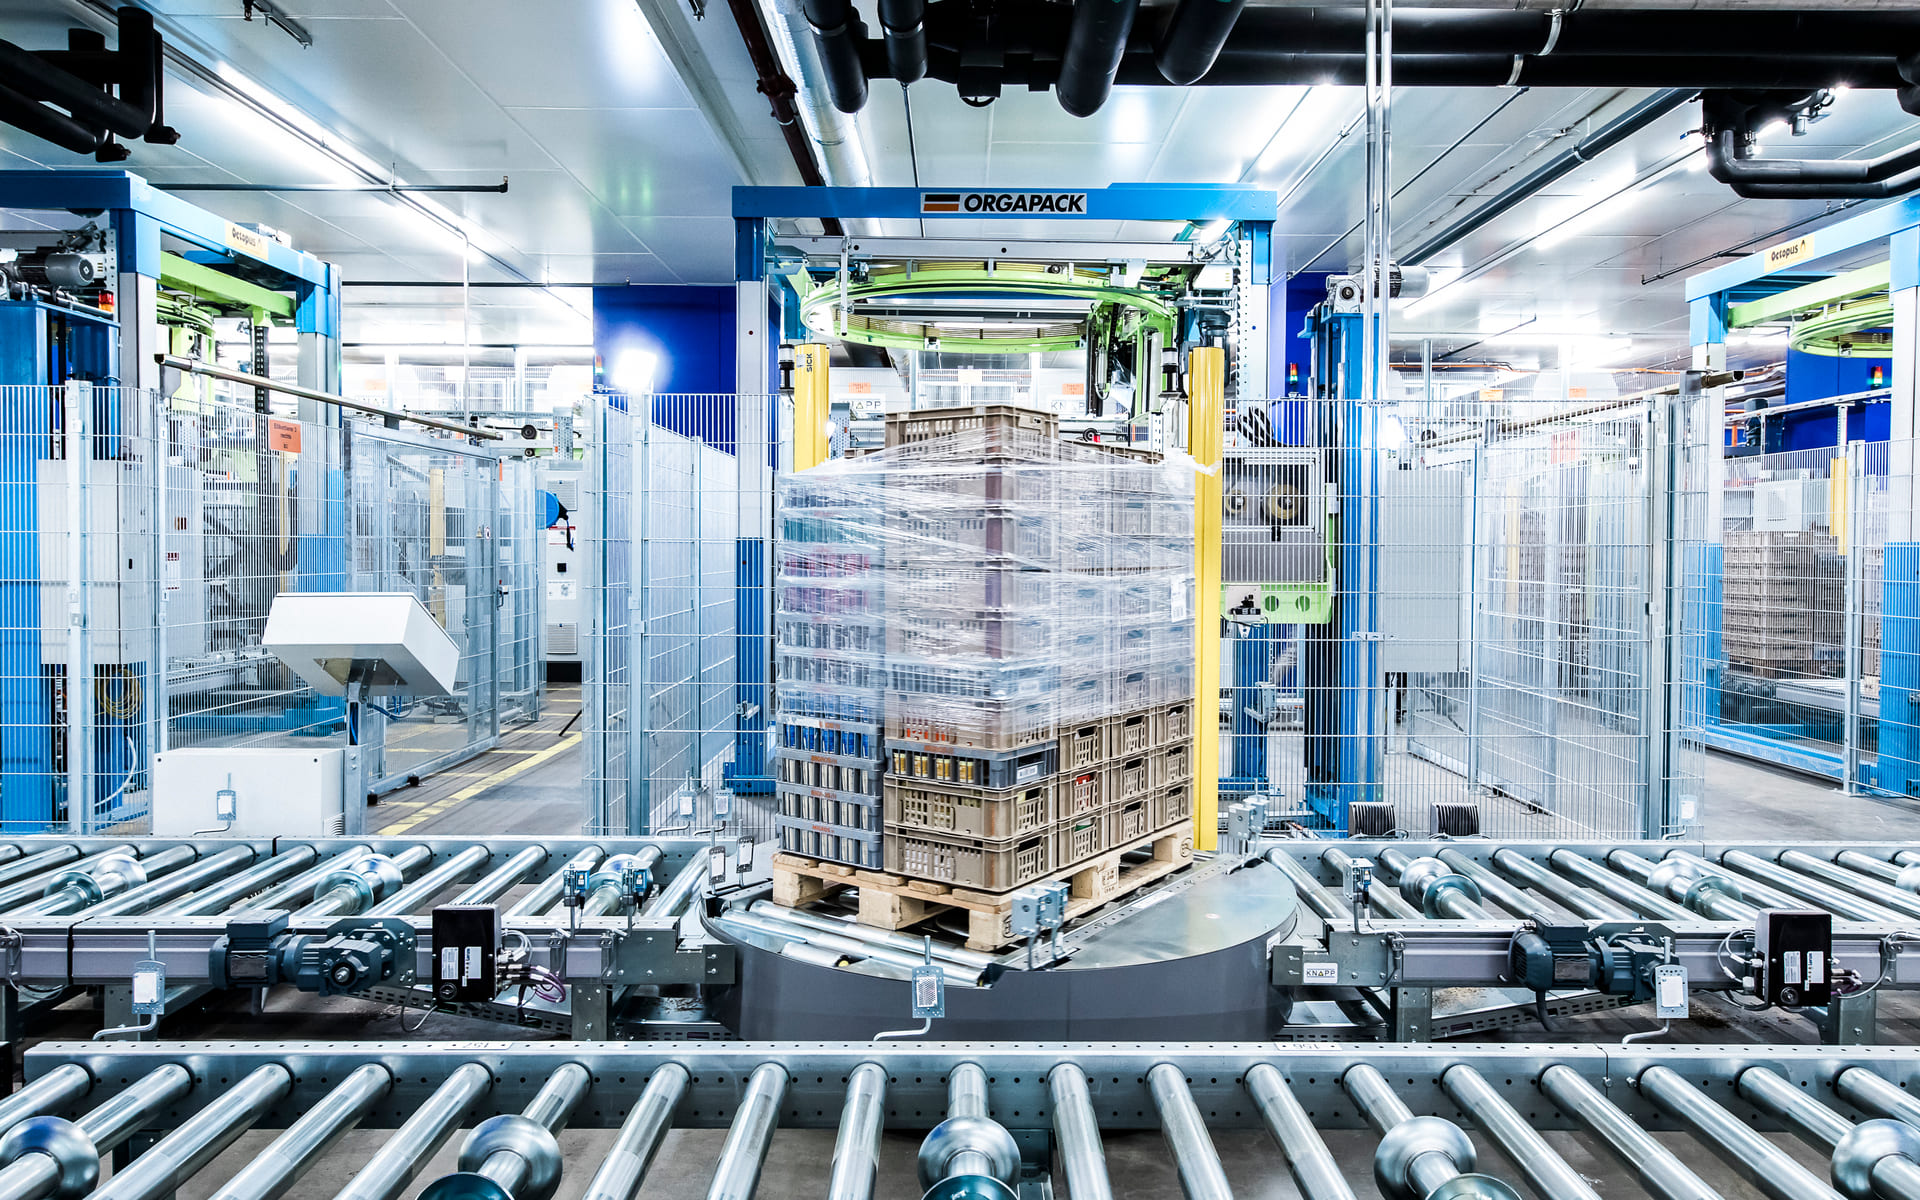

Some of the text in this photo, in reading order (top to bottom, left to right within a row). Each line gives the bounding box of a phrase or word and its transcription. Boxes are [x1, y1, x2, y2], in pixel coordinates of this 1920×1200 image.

[964, 194, 1085, 212] ORGAPACK
[232, 227, 256, 247] Octopus
[1771, 244, 1799, 262] Octopus
